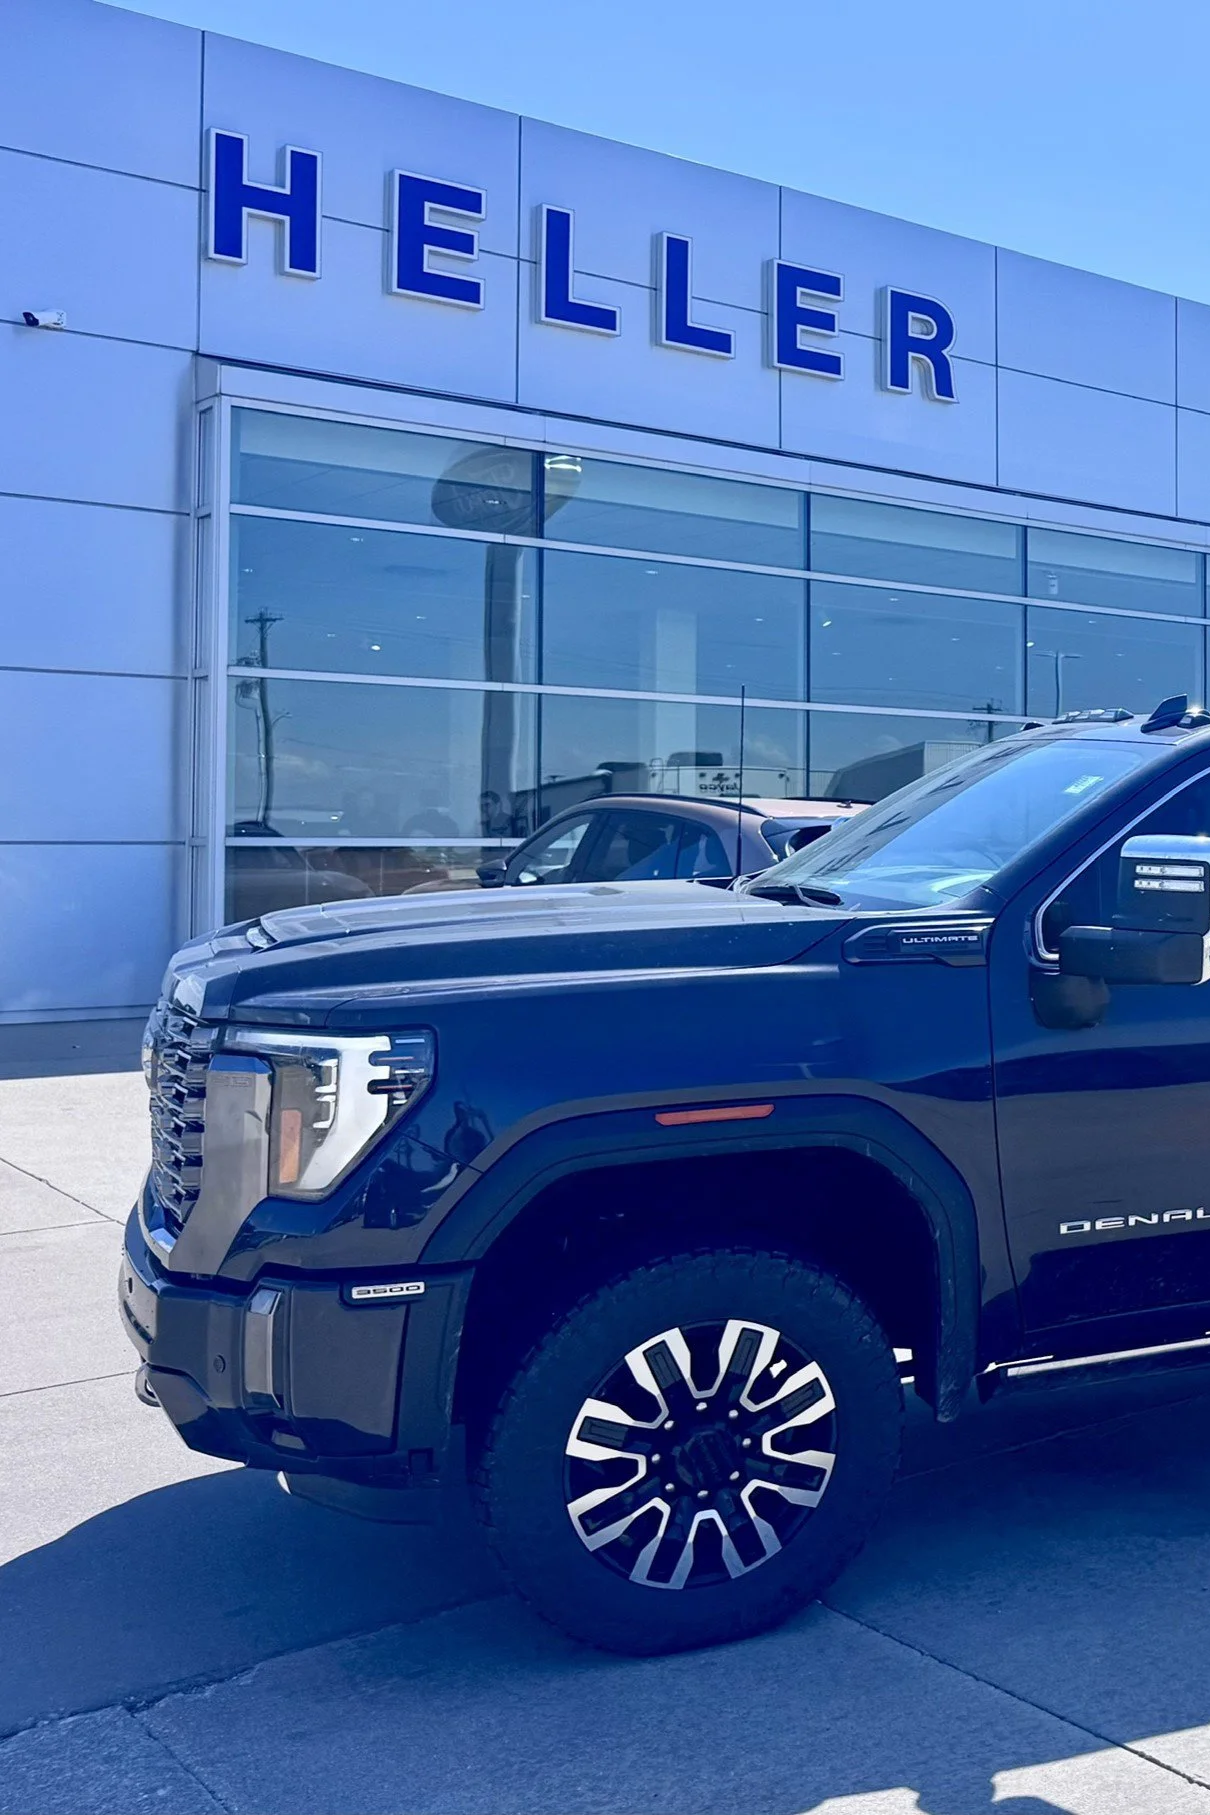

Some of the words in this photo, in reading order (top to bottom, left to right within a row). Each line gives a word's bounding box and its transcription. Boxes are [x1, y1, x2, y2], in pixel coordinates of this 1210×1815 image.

[207, 127, 960, 404] HELLER
[902, 935, 979, 944] ULTIMATE
[356, 1284, 421, 1296] 3500
